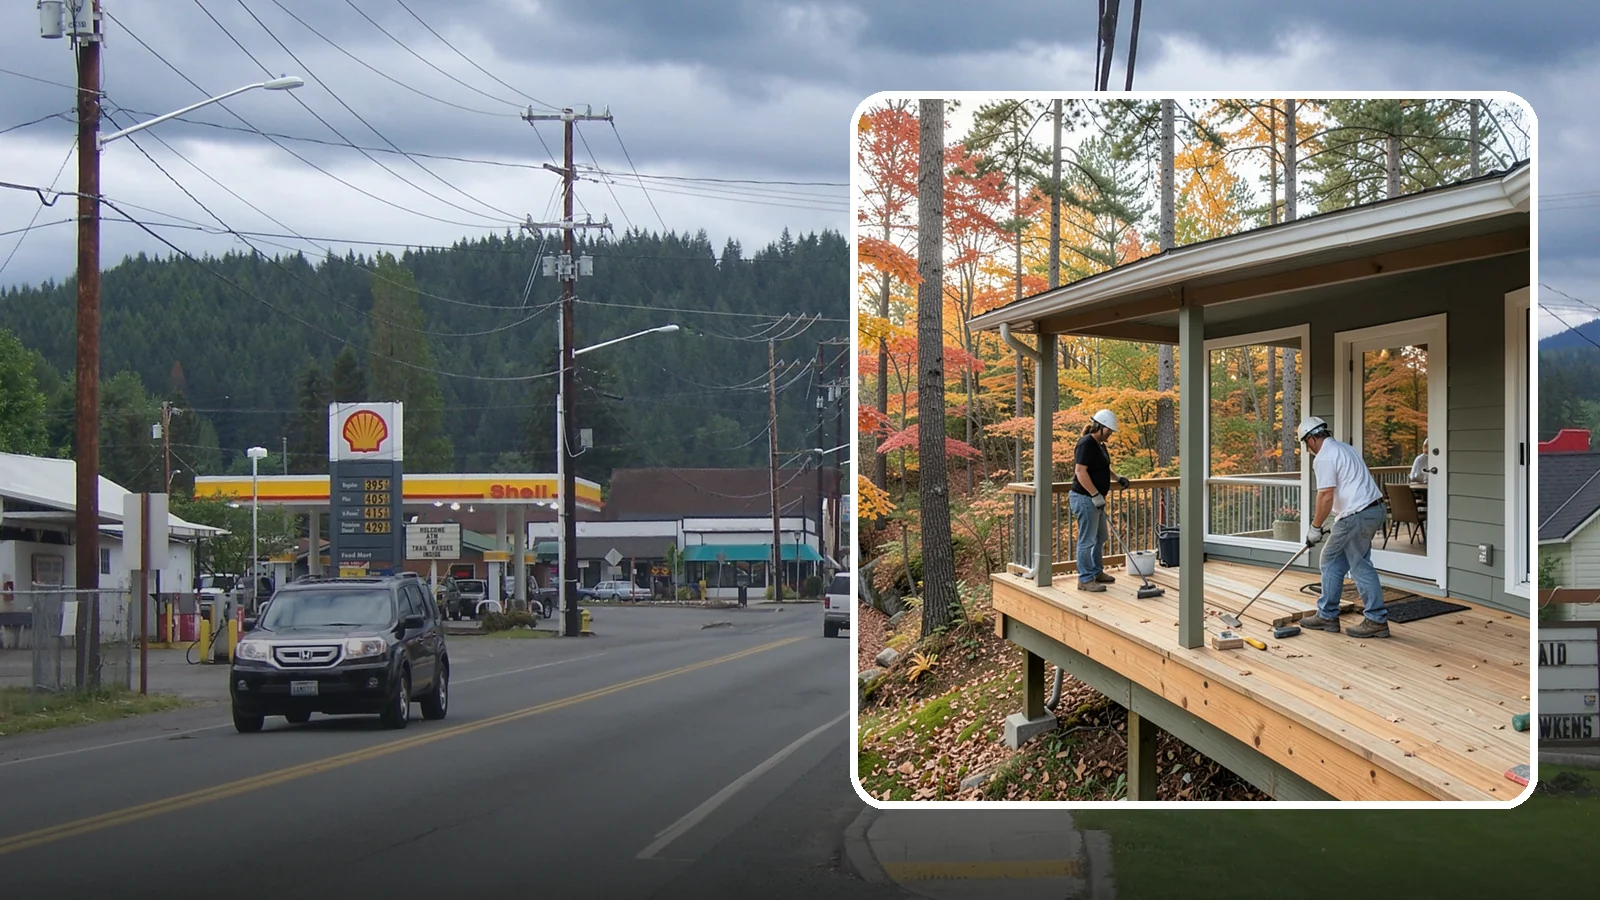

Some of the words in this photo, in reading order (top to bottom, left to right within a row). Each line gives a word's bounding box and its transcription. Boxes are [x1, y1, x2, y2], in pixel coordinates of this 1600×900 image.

[366, 480, 383, 490] 395
[490, 484, 547, 499] Shell
[366, 494, 383, 504] 405
[366, 507, 383, 518] 415
[366, 522, 383, 532] 429
